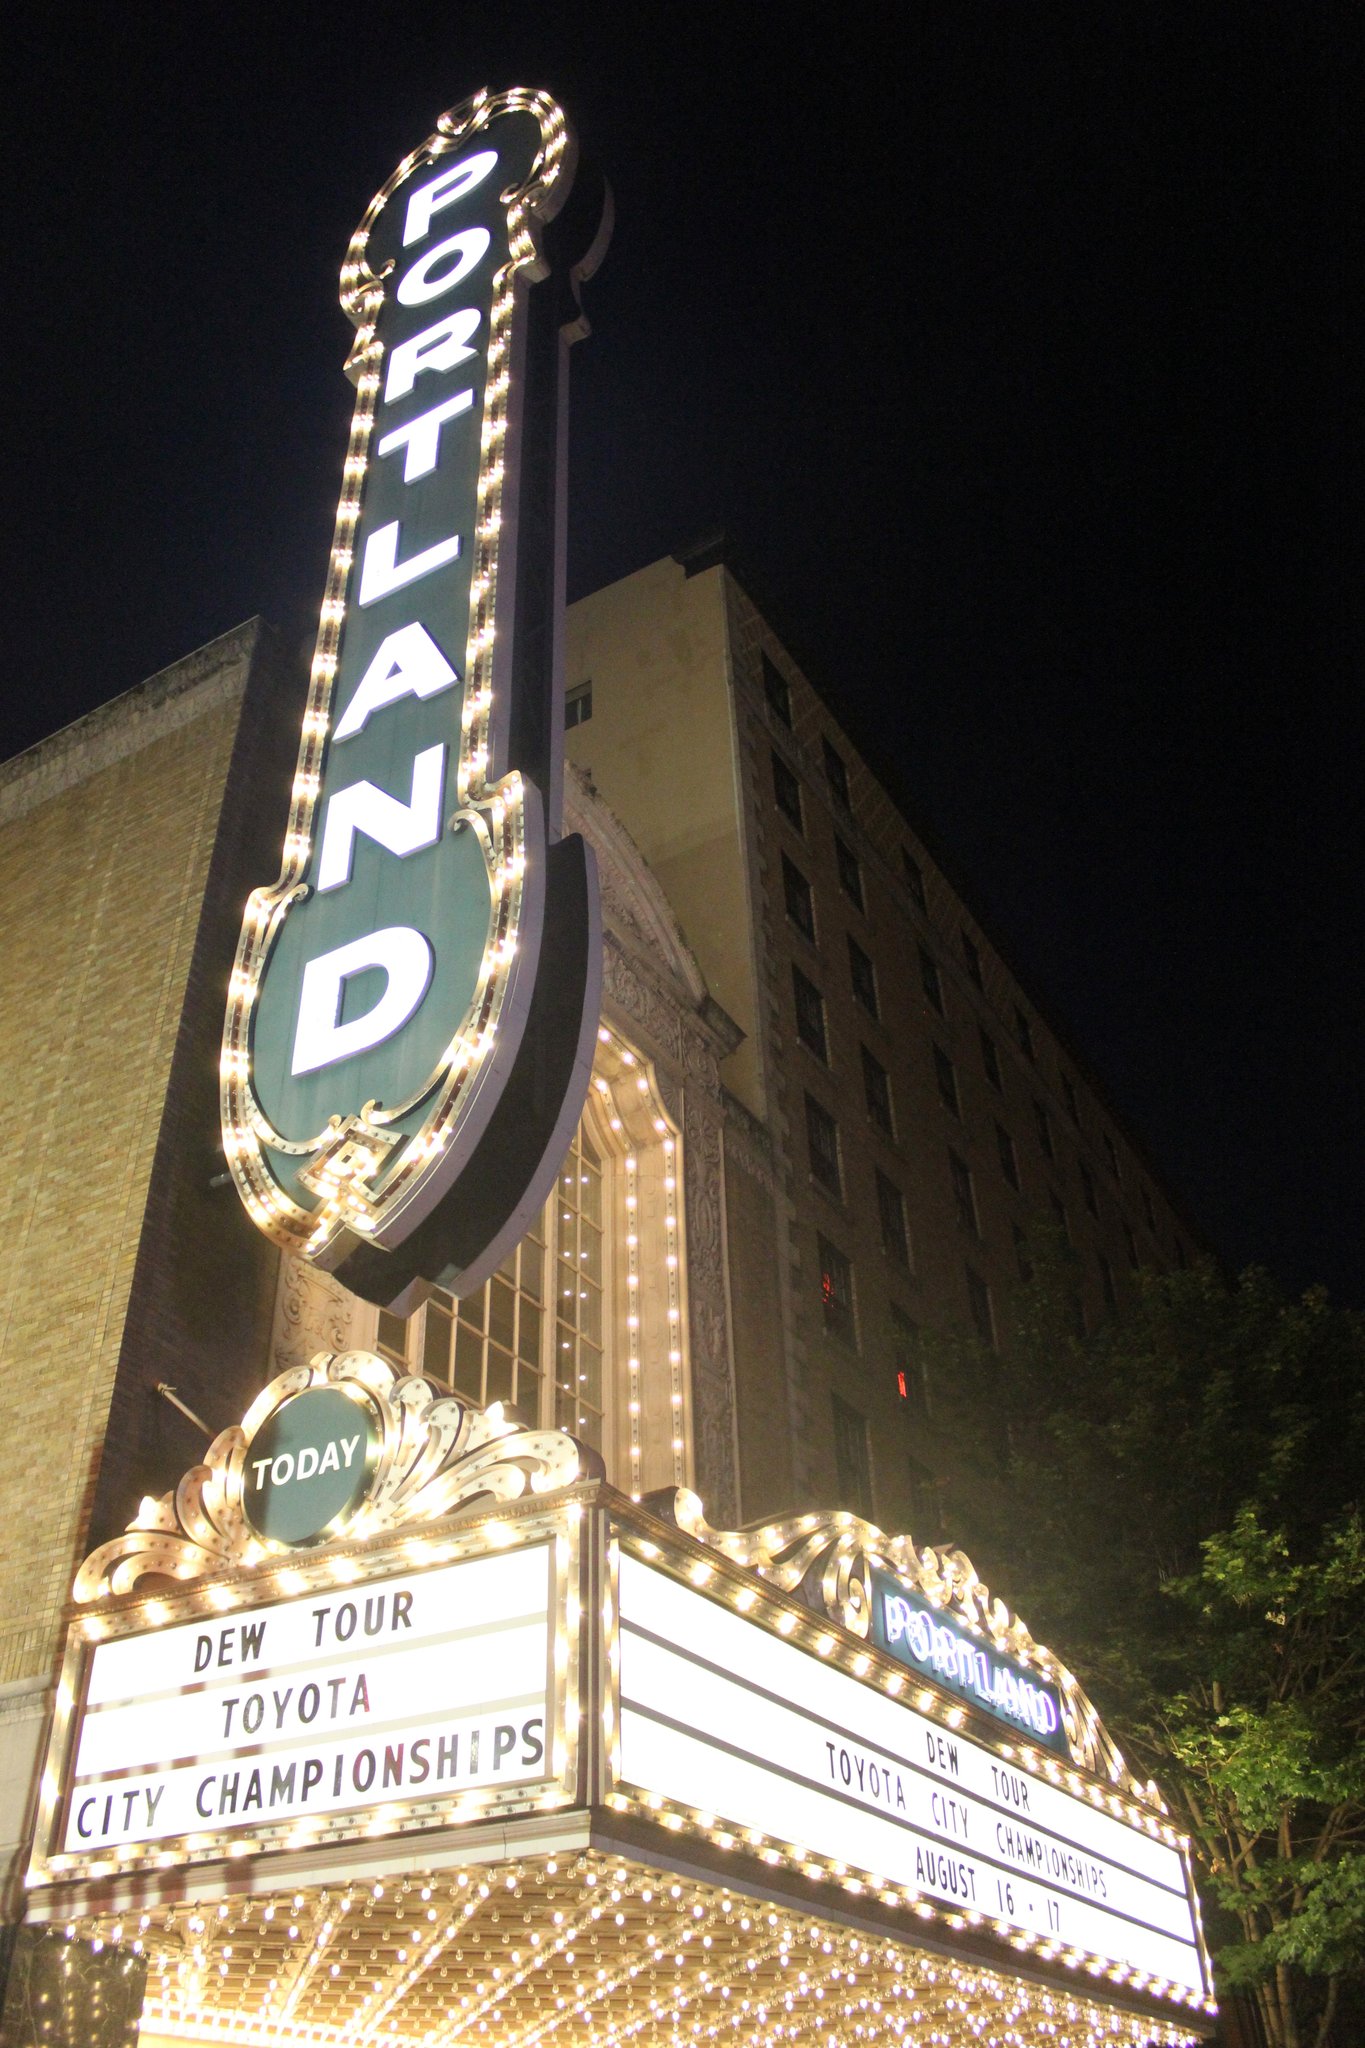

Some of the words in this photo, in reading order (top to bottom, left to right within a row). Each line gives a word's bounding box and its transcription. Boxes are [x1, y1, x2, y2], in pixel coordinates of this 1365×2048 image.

[290, 150, 499, 1077] PORTLAND
[252, 1435, 360, 1490] TODAY
[194, 1621, 267, 1672] DEW
[312, 1590, 414, 1648] TOUR
[883, 1592, 1058, 1735] PORTLAND
[222, 1674, 371, 1738] TOYOTA
[77, 1785, 166, 1838] CITY
[196, 1718, 544, 1819] CHAMPIONSHIPS
[926, 1731, 958, 1776] DEW
[991, 1765, 1030, 1811] TOUR
[826, 1741, 906, 1810] TOYOTA
[931, 1791, 968, 1838] CITY
[996, 1822, 1107, 1898] CHAMPIONSHIPS
[916, 1846, 976, 1901] AUGUST
[997, 1879, 1014, 1915] 16
[1047, 1899, 1060, 1932] 17
